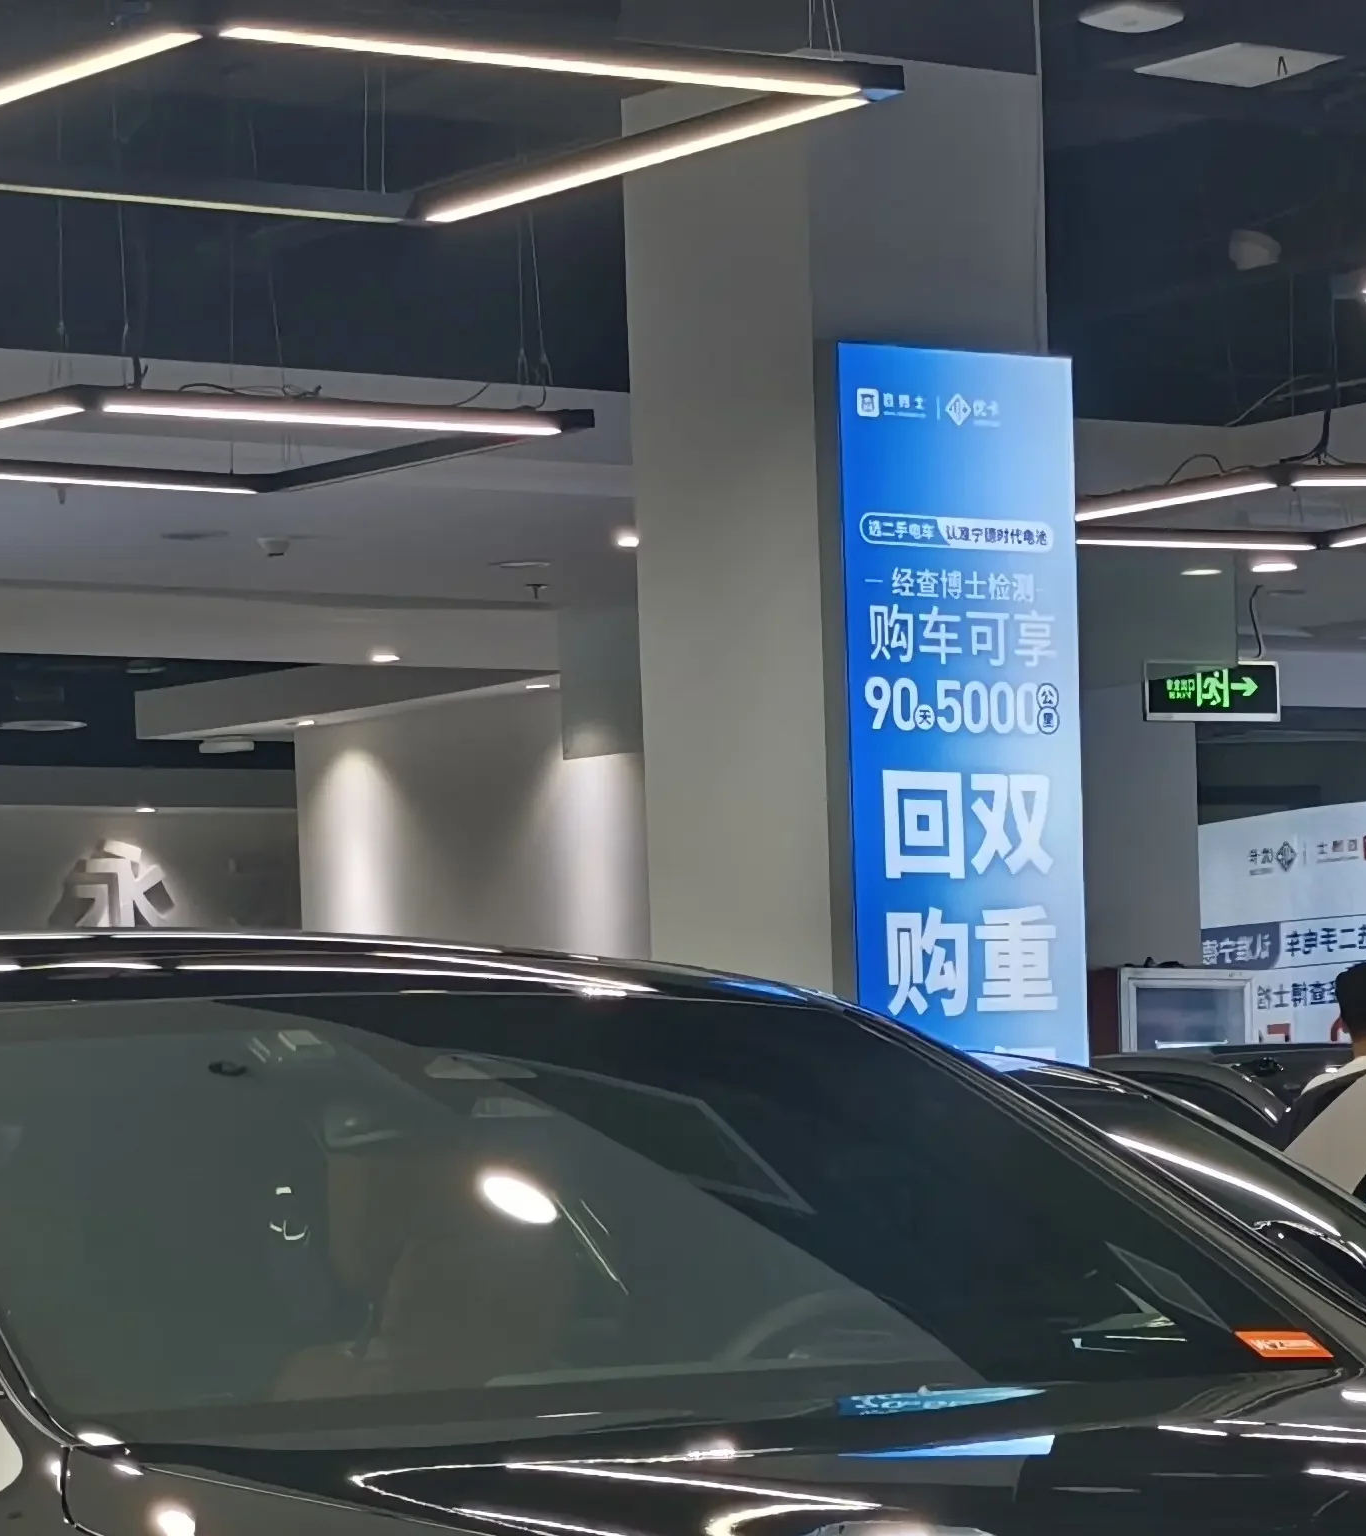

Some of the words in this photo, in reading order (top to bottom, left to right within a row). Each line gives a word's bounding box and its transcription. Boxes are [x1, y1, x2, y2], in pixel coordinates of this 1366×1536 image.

[891, 566, 1035, 604] 经查博士检测
[869, 604, 1057, 668] 购车可享
